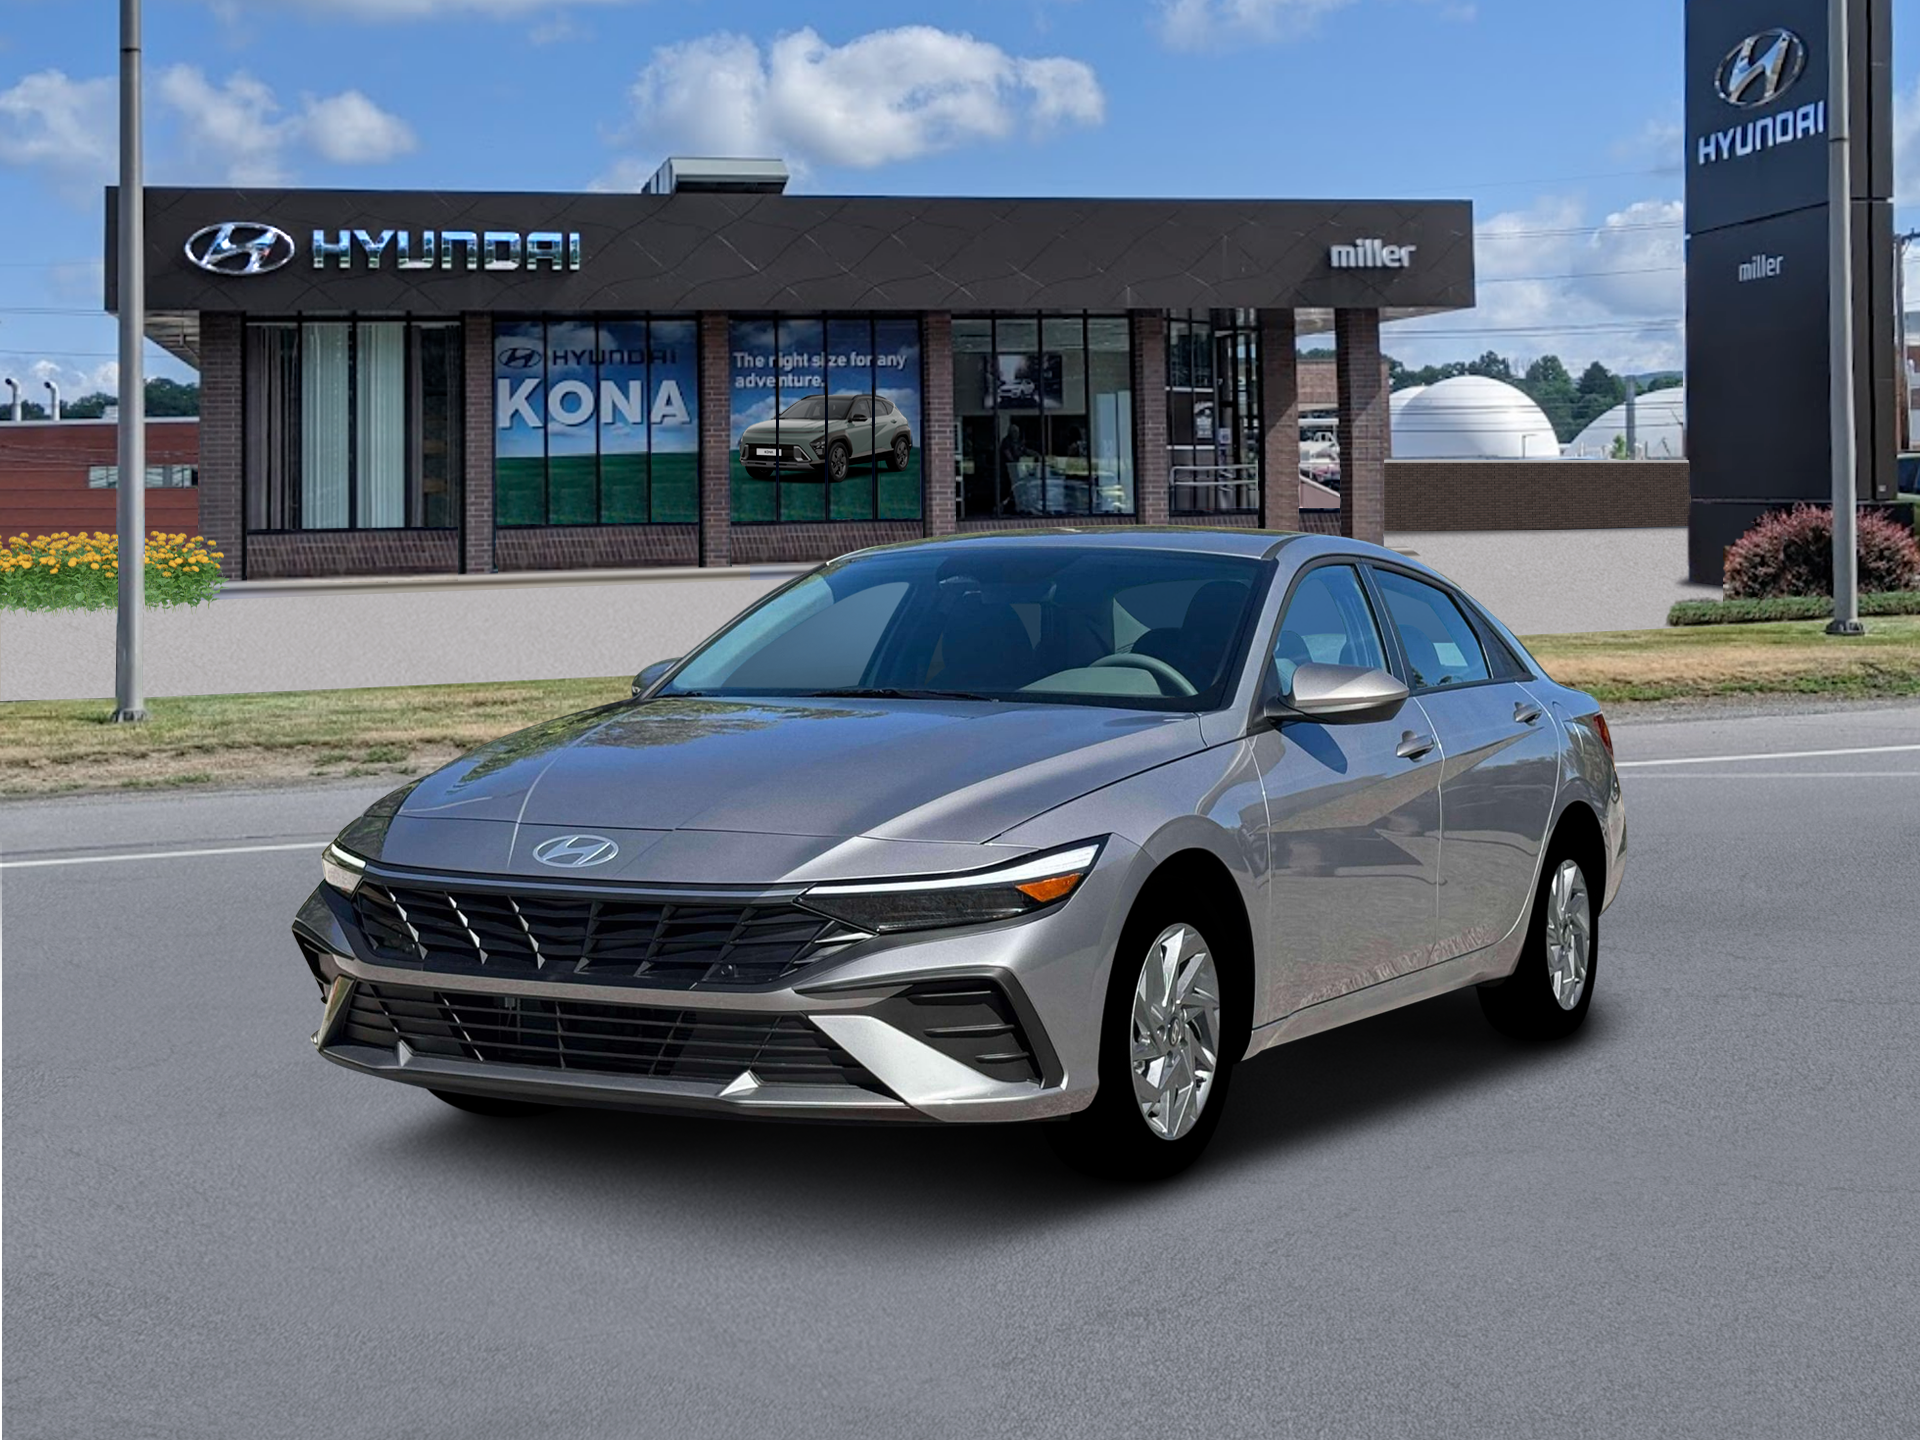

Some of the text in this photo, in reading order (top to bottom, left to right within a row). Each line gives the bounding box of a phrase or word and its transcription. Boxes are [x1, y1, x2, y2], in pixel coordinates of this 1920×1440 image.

[1698, 100, 1825, 165] HYUNDAI
[312, 230, 581, 271] HYUNDAI
[1330, 238, 1417, 267] miller
[1738, 254, 1784, 282] miller
[552, 349, 677, 366] HYUNDAI
[733, 352, 907, 371] The right size for any
[735, 373, 825, 388] adventure.
[497, 378, 691, 430] KONA
